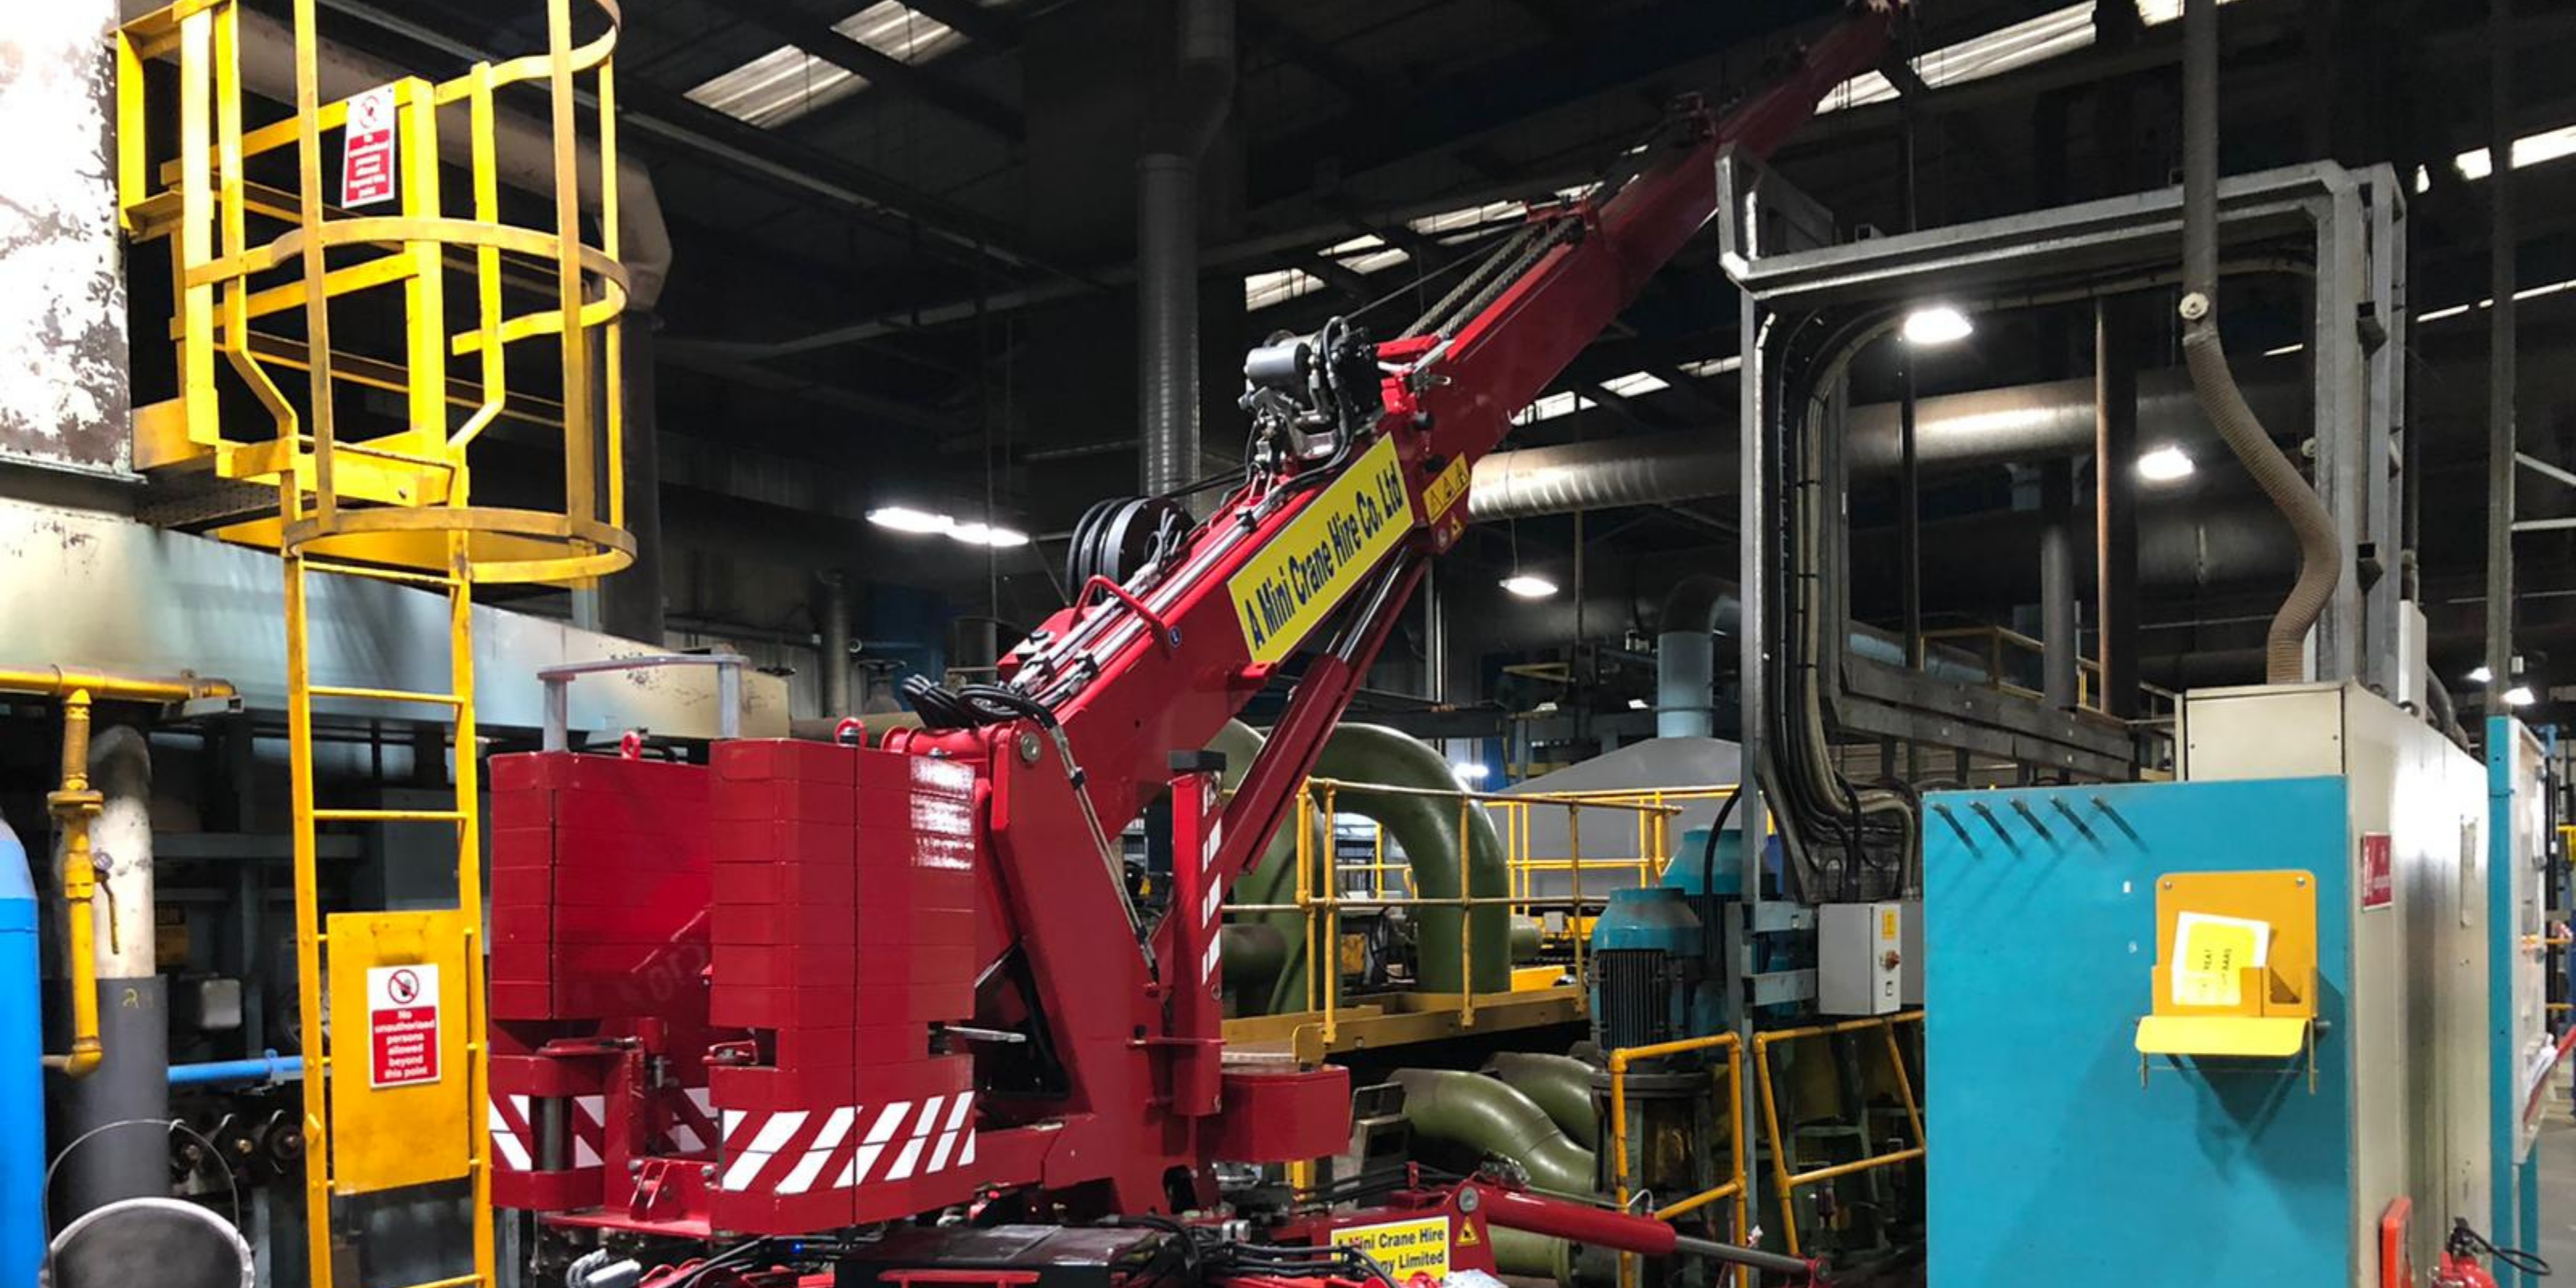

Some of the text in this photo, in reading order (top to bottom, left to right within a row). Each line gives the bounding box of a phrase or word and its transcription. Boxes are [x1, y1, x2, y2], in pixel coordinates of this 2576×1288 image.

[1245, 460, 1404, 650] A Mini Crane Hire Co. Ltd
[398, 1010, 412, 1020] No
[386, 1033, 425, 1045] persons
[387, 1043, 424, 1055] allowed
[388, 1055, 424, 1067] beyond
[384, 1066, 428, 1080] this point
[1379, 1232, 1416, 1249] Crane
[1419, 1228, 1444, 1243] Hire
[1399, 1250, 1444, 1269] Limited
